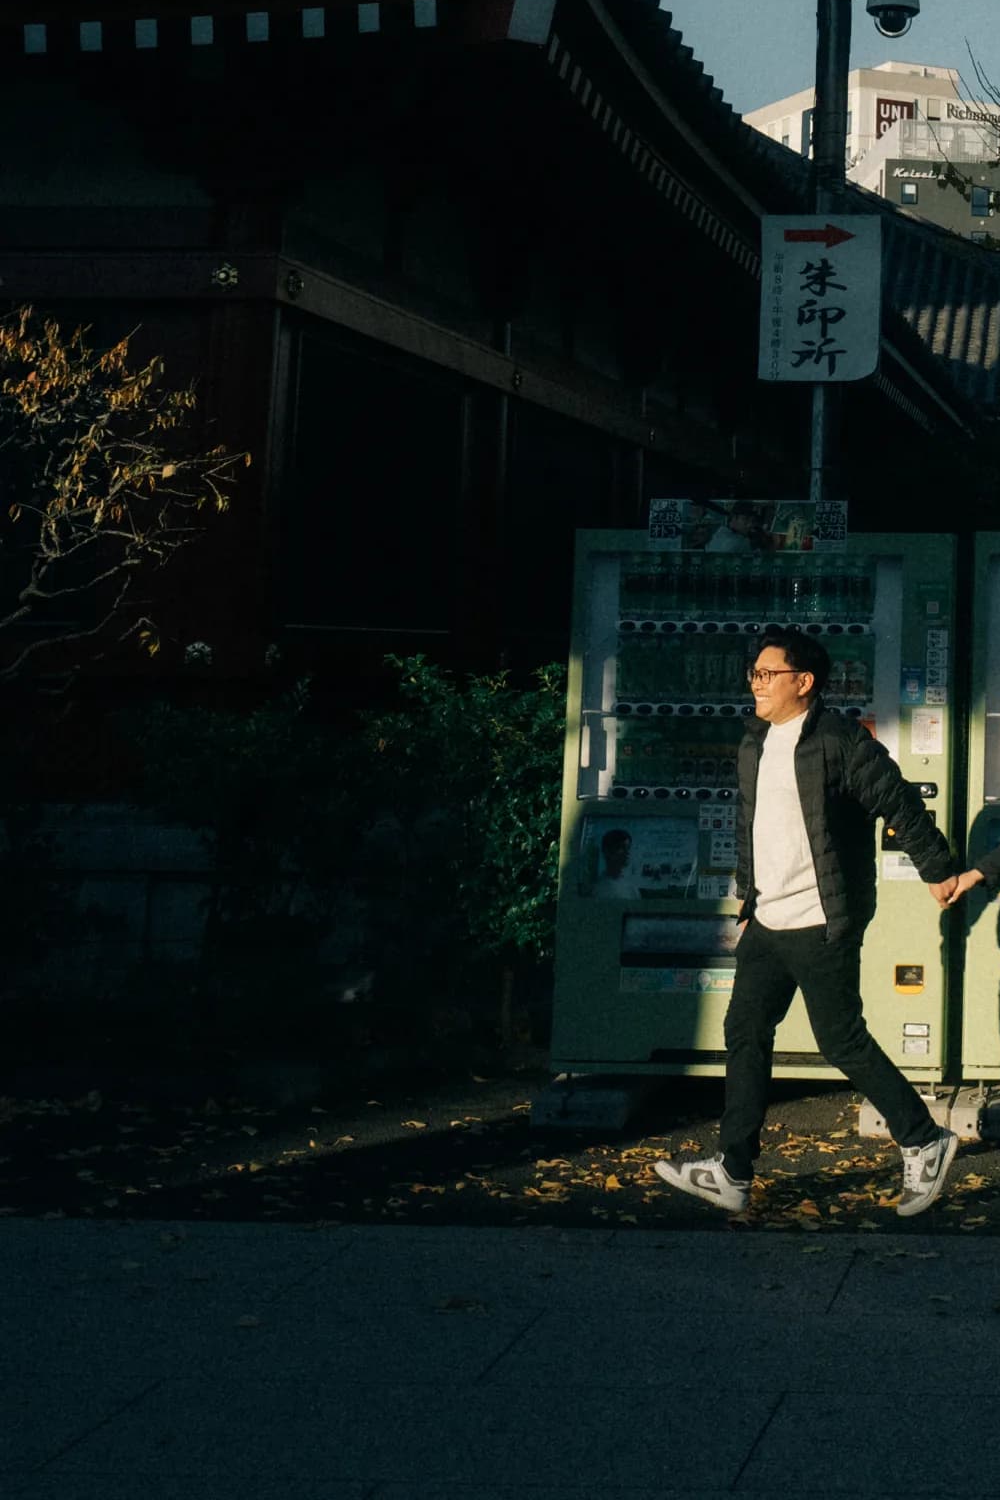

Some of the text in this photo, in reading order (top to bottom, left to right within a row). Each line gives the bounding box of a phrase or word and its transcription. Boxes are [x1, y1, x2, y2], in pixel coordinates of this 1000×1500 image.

[880, 103, 908, 120] UNI
[789, 257, 848, 377] 朱印所
